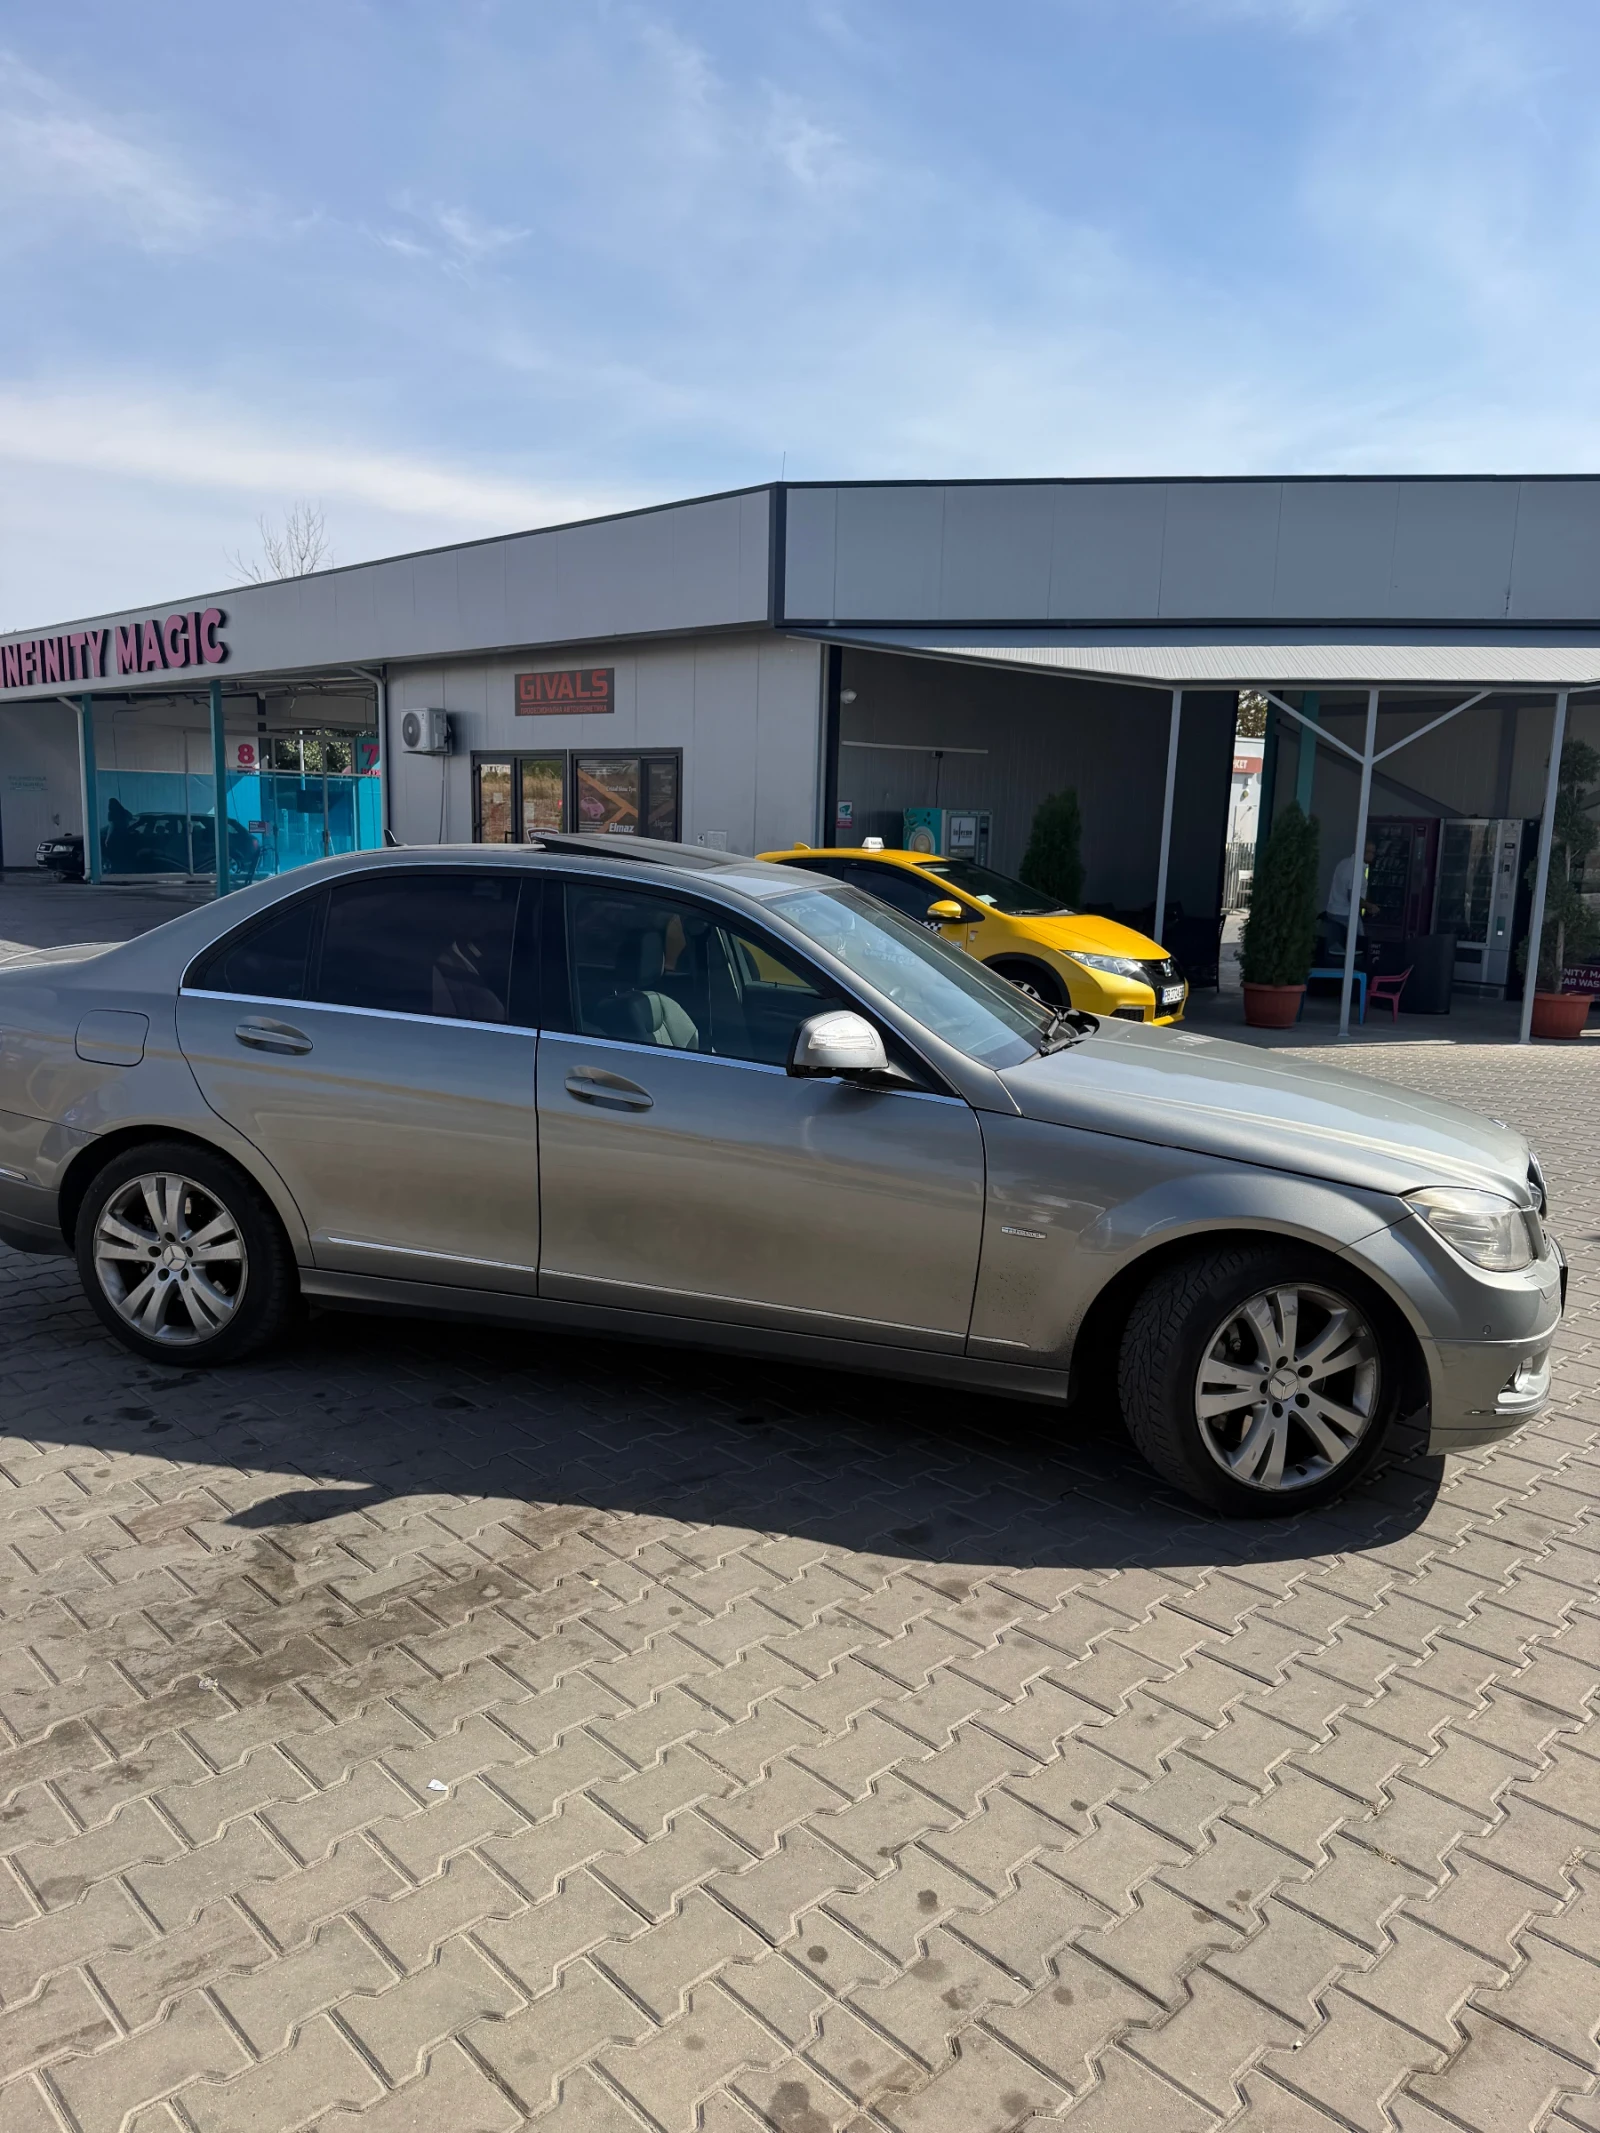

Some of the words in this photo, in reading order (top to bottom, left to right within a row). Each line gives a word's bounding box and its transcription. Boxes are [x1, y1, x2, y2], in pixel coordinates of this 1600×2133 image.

[0, 629, 107, 688] INFINITY
[115, 608, 227, 674] MAGIC
[520, 670, 608, 700] GIVALS
[237, 744, 255, 764] 8
[362, 744, 380, 766] 7
[1233, 759, 1248, 769] KET
[609, 823, 635, 833] Elmaz
